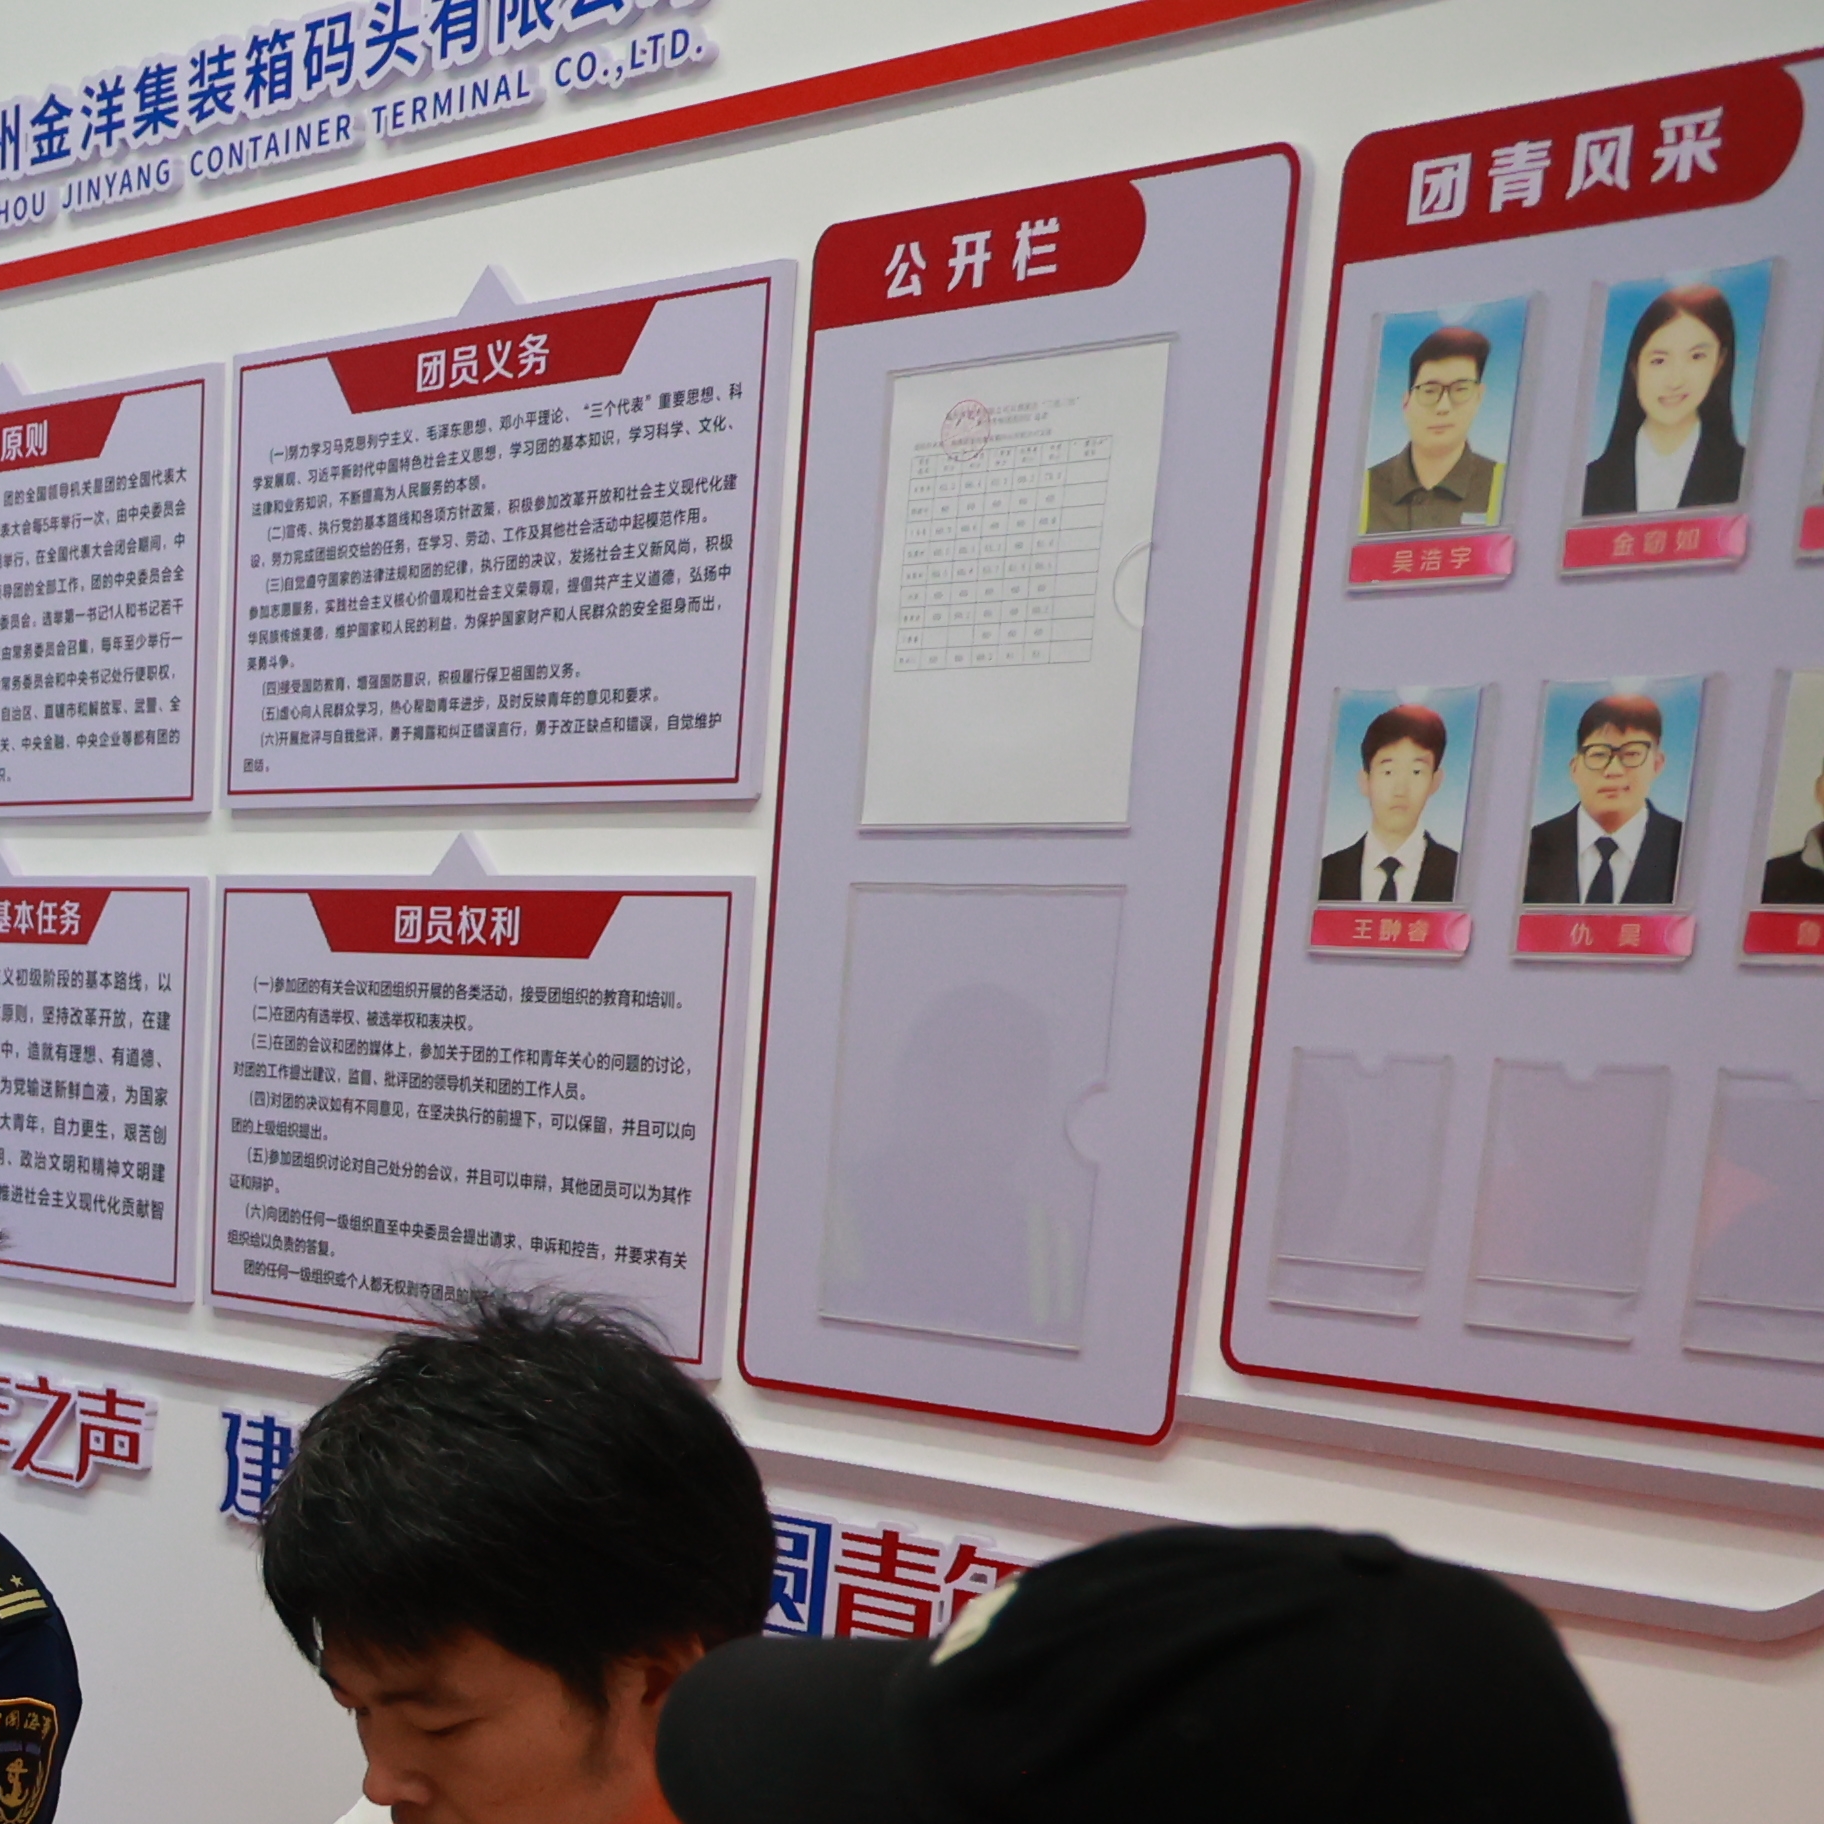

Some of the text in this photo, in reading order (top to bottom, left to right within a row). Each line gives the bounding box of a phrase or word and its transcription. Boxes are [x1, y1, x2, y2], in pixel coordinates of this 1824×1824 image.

[61, 163, 173, 211] JINYANG
[188, 113, 352, 176] CONTAINER
[373, 69, 531, 134] TERMINAL
[555, 28, 703, 87] CO.,LTD.
[1406, 106, 1724, 226] 团青风采
[884, 217, 1059, 298] 公开栏
[415, 333, 550, 393] 团员义务
[393, 904, 521, 946] 团员权利
[220, 1411, 296, 1518] 建
